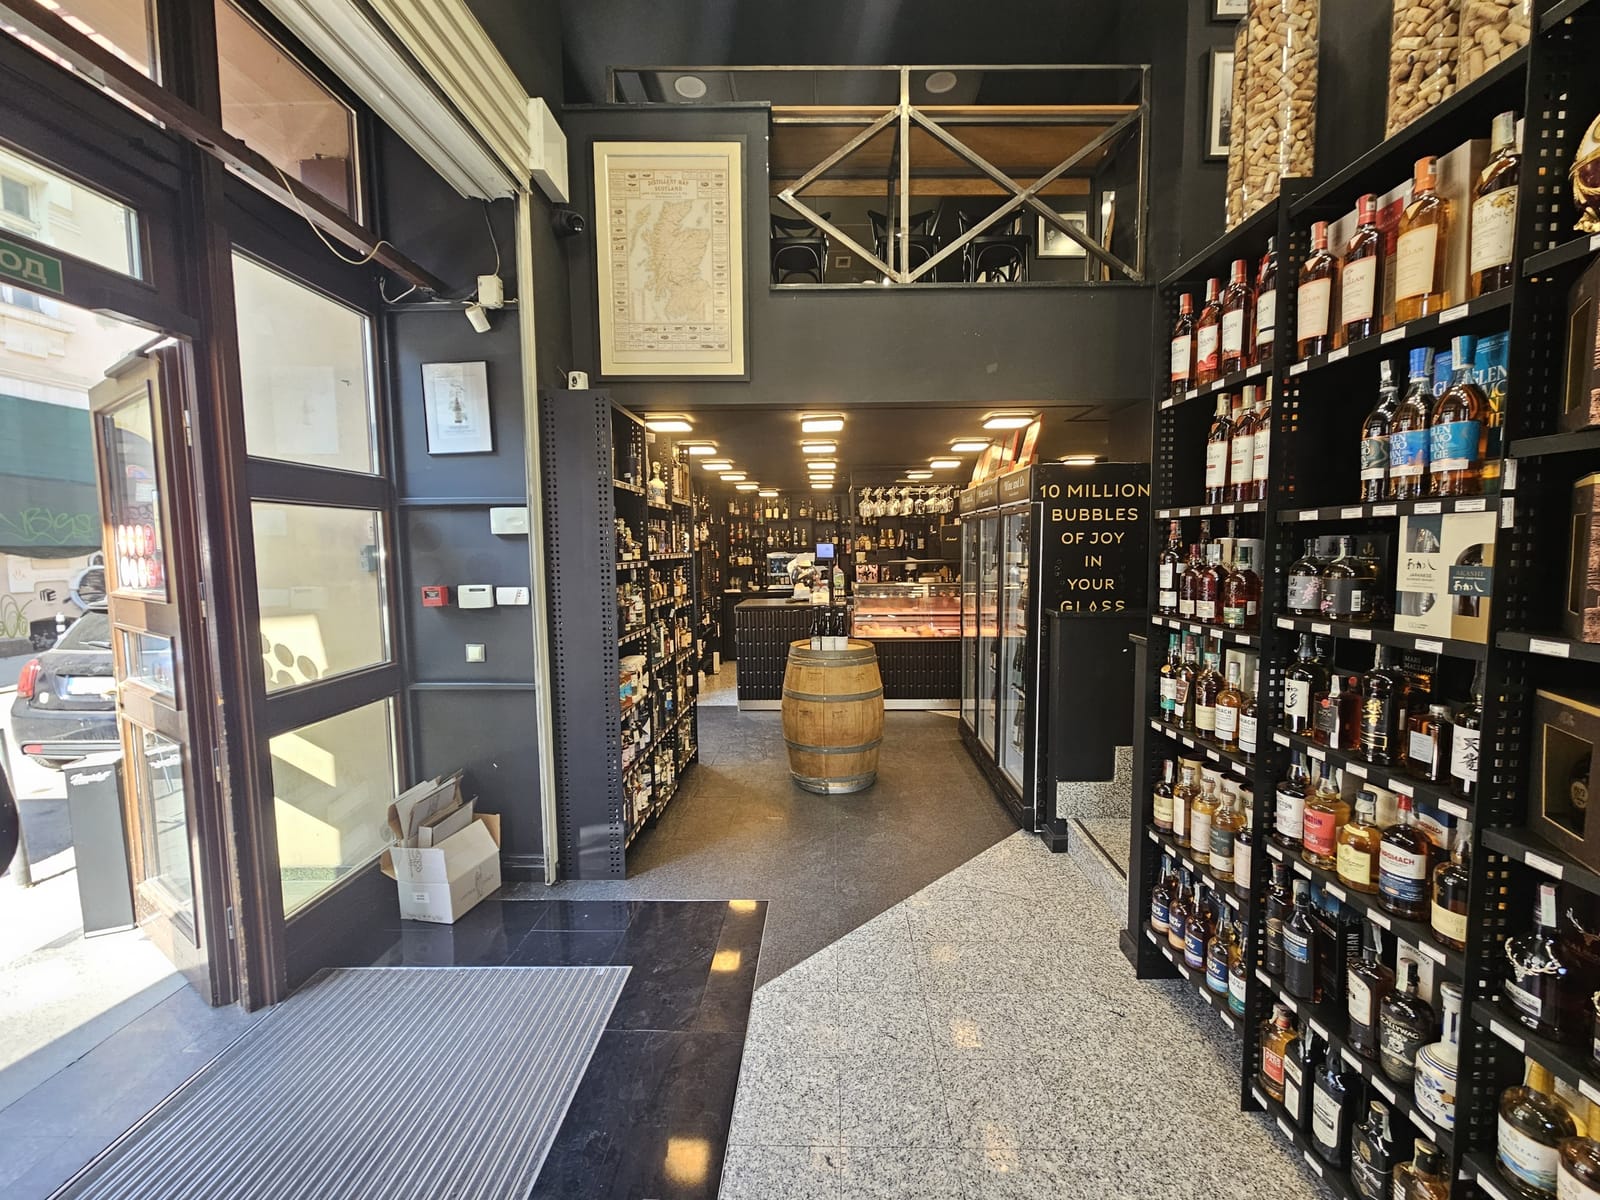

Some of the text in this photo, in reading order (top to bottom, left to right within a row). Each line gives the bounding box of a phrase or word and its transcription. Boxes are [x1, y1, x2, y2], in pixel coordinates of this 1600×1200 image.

[1040, 483, 1151, 499] 10 MILLION
[1051, 507, 1138, 522] BUBBLES
[1061, 531, 1125, 545] OF JOY
[1084, 555, 1102, 568] IN
[1067, 578, 1115, 591] YOUR
